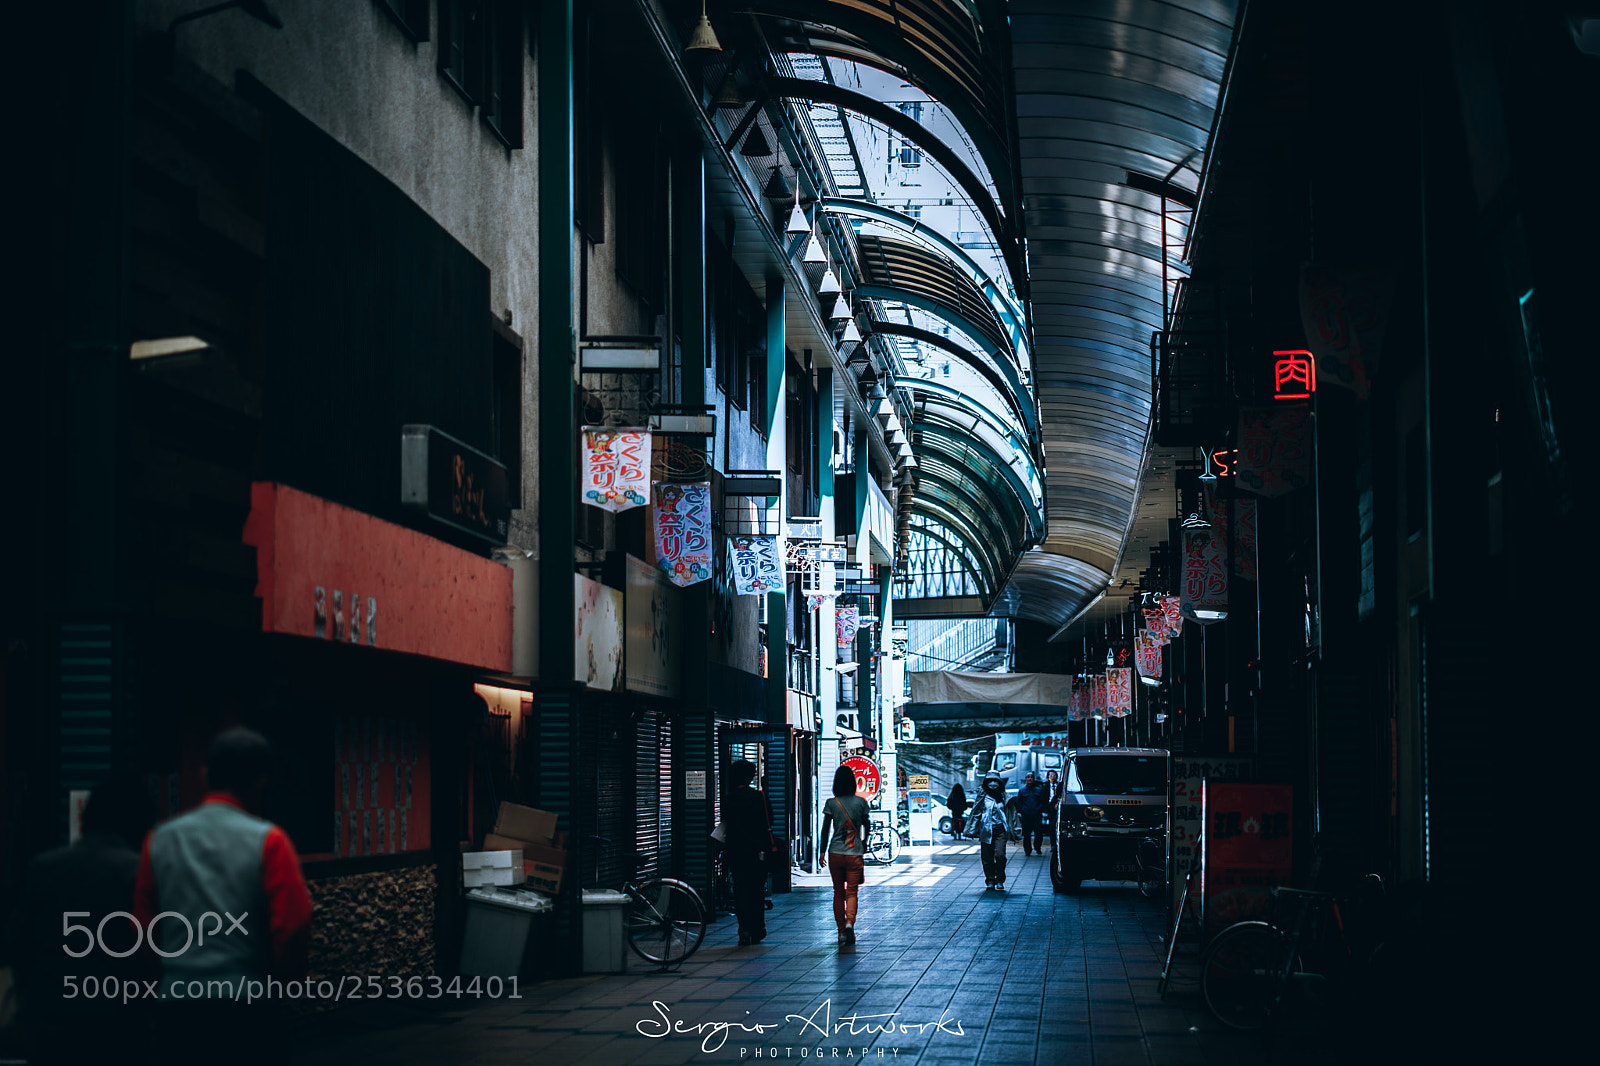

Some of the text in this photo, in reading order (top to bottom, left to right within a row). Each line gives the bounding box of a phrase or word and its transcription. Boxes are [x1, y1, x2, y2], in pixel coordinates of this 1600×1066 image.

[589, 453, 616, 489] 祭り
[620, 431, 643, 481] さくら
[658, 513, 684, 562] 祭り
[684, 486, 707, 551] さくら
[736, 551, 757, 581] 祭り
[1186, 558, 1207, 600] 祭り
[1144, 646, 1156, 673] 祭り
